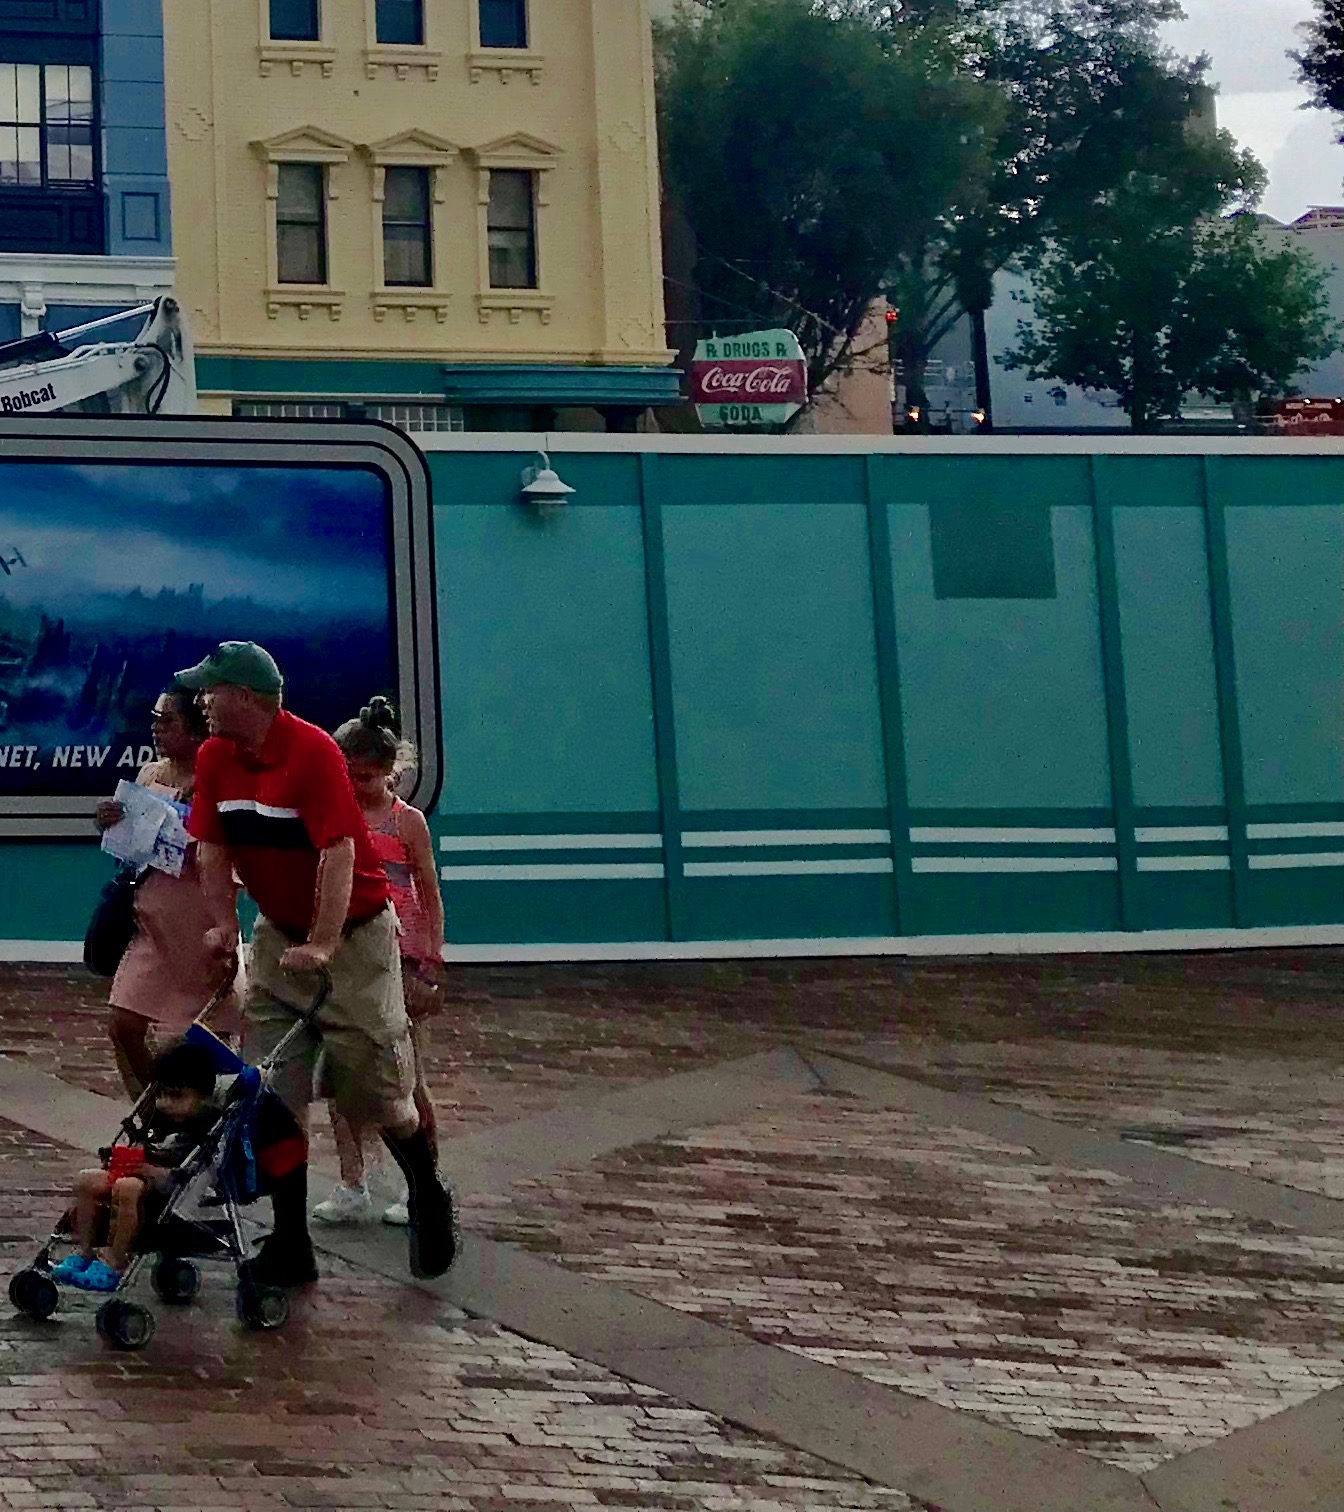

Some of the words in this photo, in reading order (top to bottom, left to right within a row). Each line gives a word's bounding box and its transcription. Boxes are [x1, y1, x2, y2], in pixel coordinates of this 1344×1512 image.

[723, 342, 770, 357] DRUGS
[701, 366, 793, 393] Coca-Cola
[1, 383, 57, 411] Bobcat
[52, 744, 111, 768] NEW
